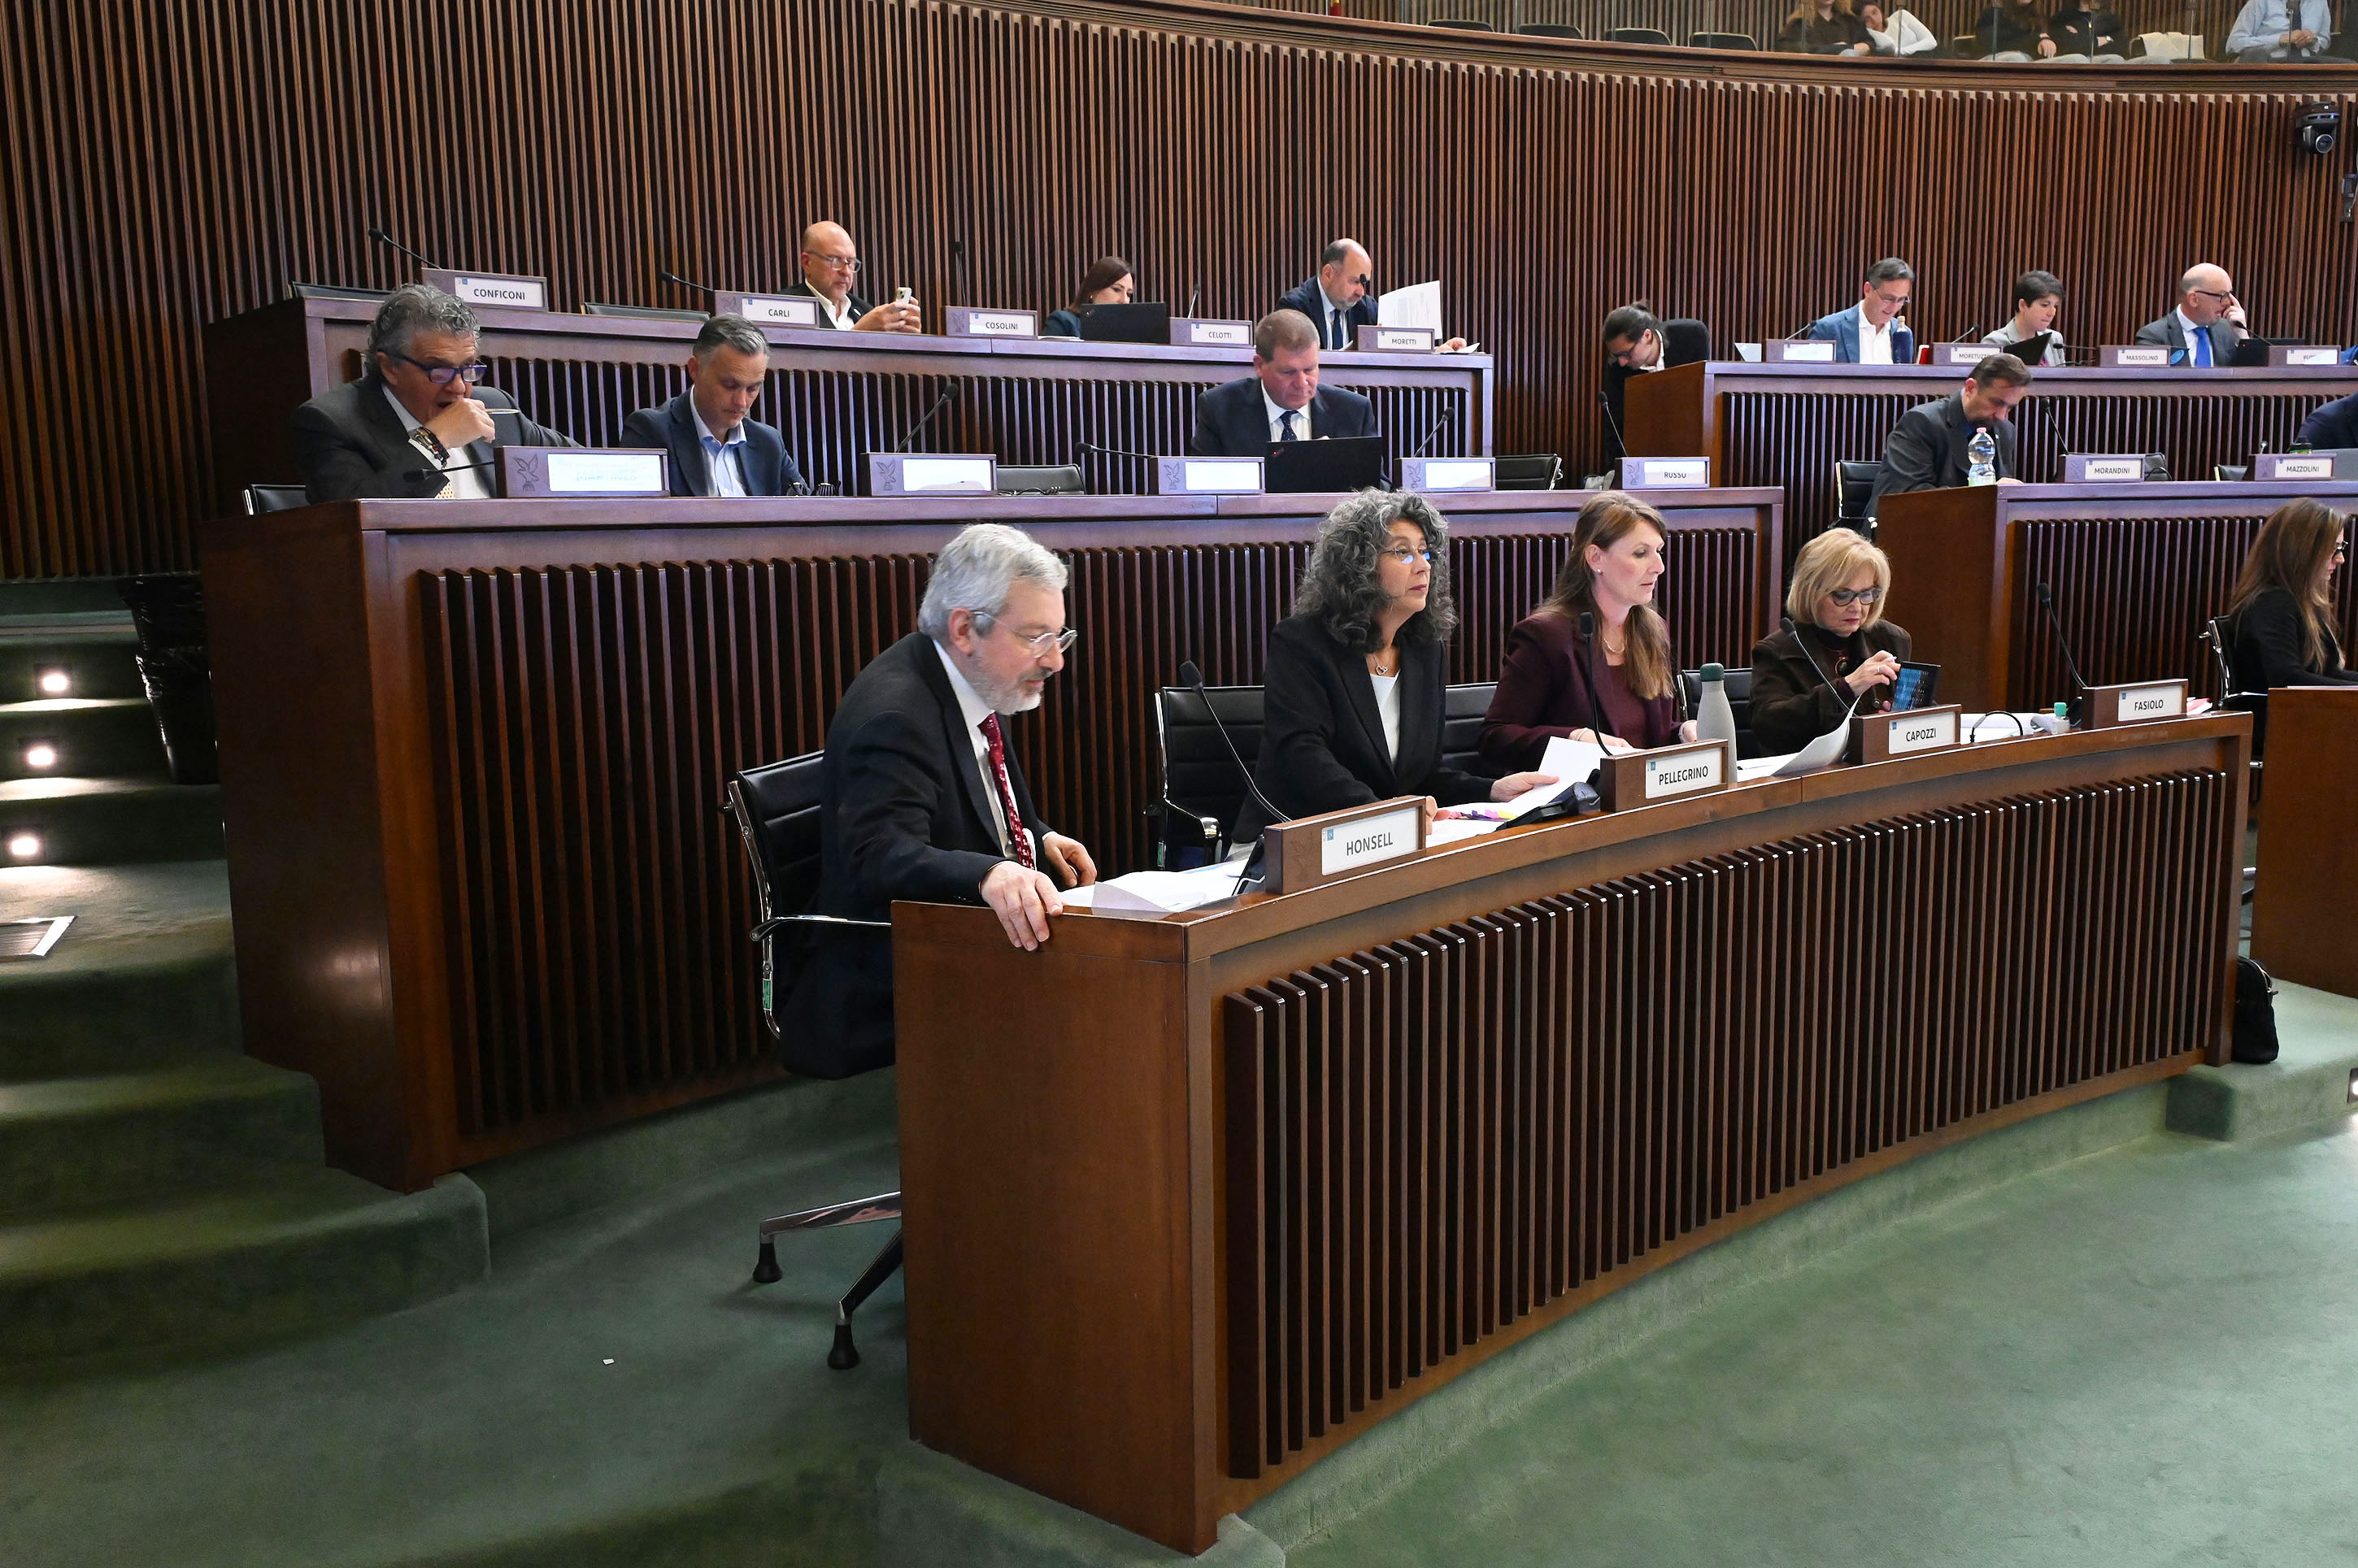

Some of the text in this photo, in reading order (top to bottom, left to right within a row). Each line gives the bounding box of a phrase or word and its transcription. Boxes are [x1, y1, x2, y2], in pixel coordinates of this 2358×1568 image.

[473, 288, 525, 300] CONFICONI
[768, 308, 790, 318] CARLI
[985, 321, 1018, 330] COSOLINI
[1208, 331, 1232, 339] CELOTTI
[2134, 699, 2164, 711] FASIOLO
[1905, 728, 1937, 741] CAPOZZI
[1659, 766, 1708, 785] PELLEGRINO
[1346, 832, 1394, 856] HONSELL
